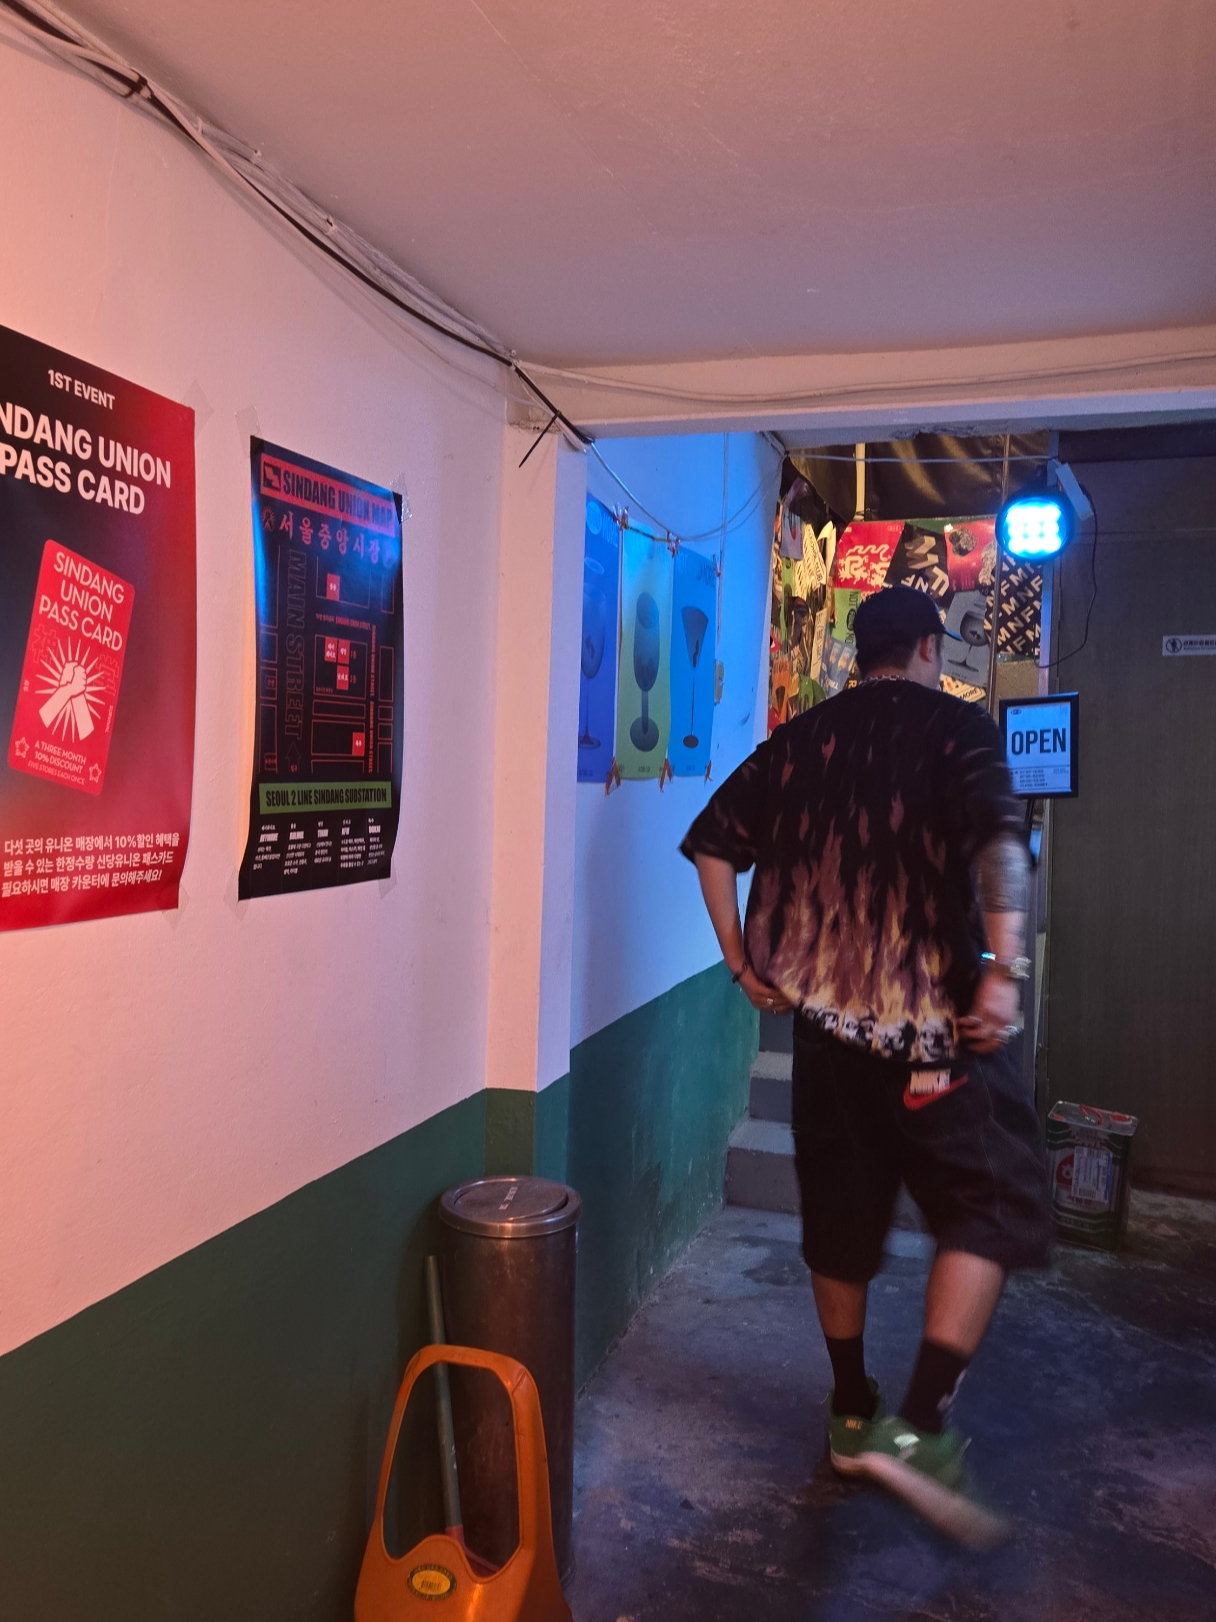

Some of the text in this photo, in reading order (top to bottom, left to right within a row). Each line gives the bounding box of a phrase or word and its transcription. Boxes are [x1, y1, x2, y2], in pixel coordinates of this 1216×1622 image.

[48, 369, 115, 410] 1ST EVENT
[0, 442, 145, 515] PASS CARD
[98, 435, 171, 489] UNION
[282, 470, 393, 530] SINDANG UNION MAP
[54, 551, 125, 604] SINDANG
[60, 579, 113, 623] UNION
[38, 594, 123, 651] PASS CARD
[285, 634, 305, 741] STREET
[34, 740, 86, 764] A THREE MONTH
[1011, 727, 1066, 756] OPEN
[27, 760, 85, 785] FIVE STORES EACH ONCE
[35, 751, 83, 774] 10% DISCOUNT
[265, 787, 387, 808] SEOUL 2 LINE SINDANG SUBSTATION
[4, 839, 24, 856] 다섯
[25, 838, 43, 854] 곳의
[45, 836, 73, 853] 유니온
[75, 836, 112, 851] 매장에서
[155, 832, 180, 847] 혜택을
[3, 851, 174, 877] 받을 수 있는 한정수량 신당유니온 패스카드
[1, 869, 162, 898] 필요하시면 매장 카운터에 문의해주세요!
